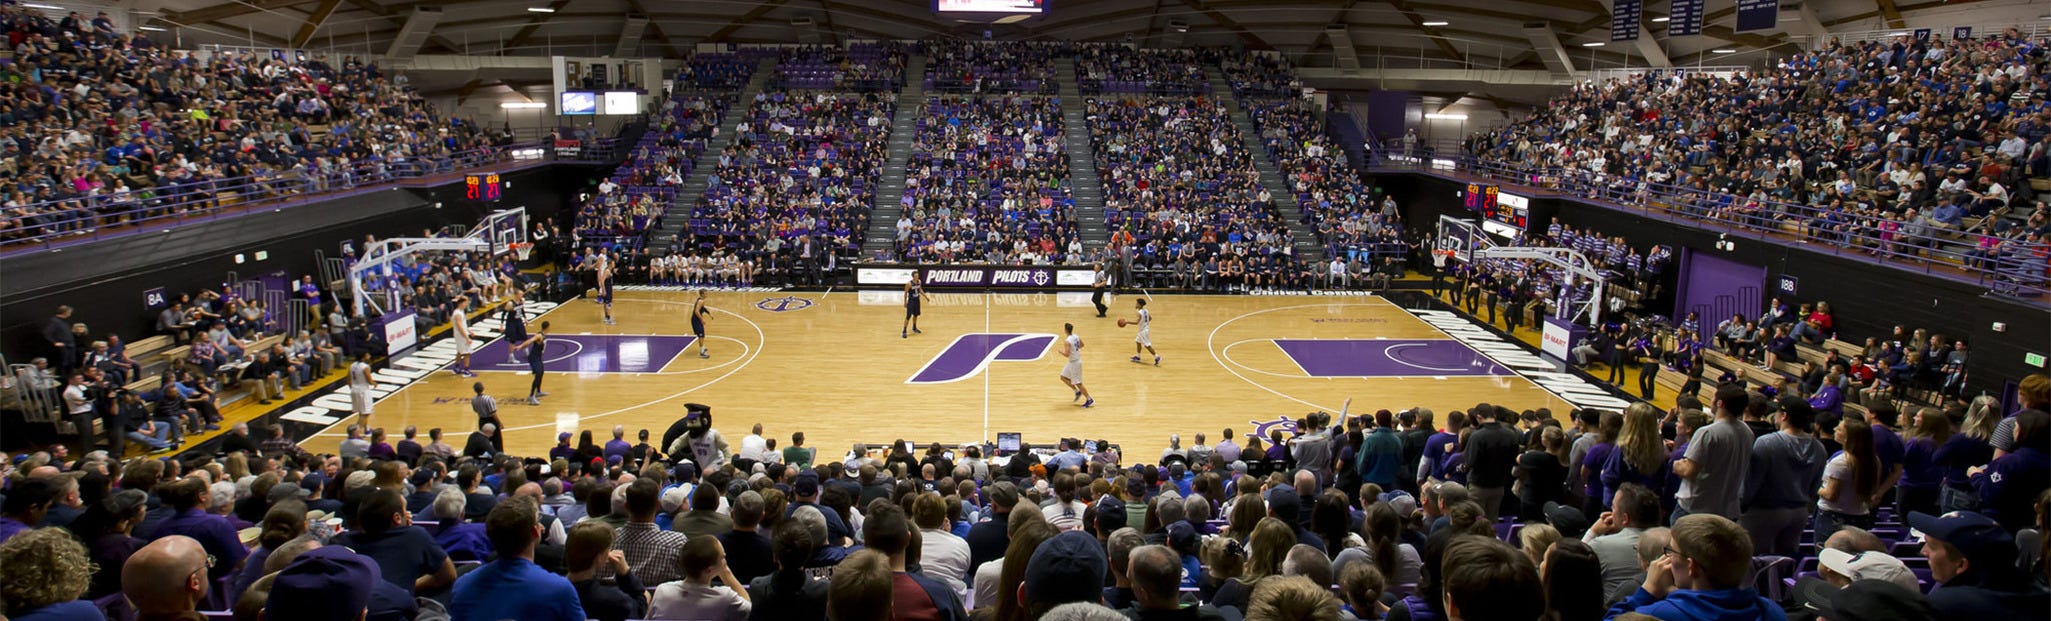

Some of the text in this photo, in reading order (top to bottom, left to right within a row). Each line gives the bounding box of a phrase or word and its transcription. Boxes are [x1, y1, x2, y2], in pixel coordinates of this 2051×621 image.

[1917, 31, 1928, 41] 17
[1957, 29, 1967, 39] 18
[466, 184, 480, 200] 27
[1483, 194, 1497, 209] 27
[925, 269, 983, 284] PORTLAND
[992, 269, 1030, 284] PILOTS
[147, 292, 164, 306] 8A
